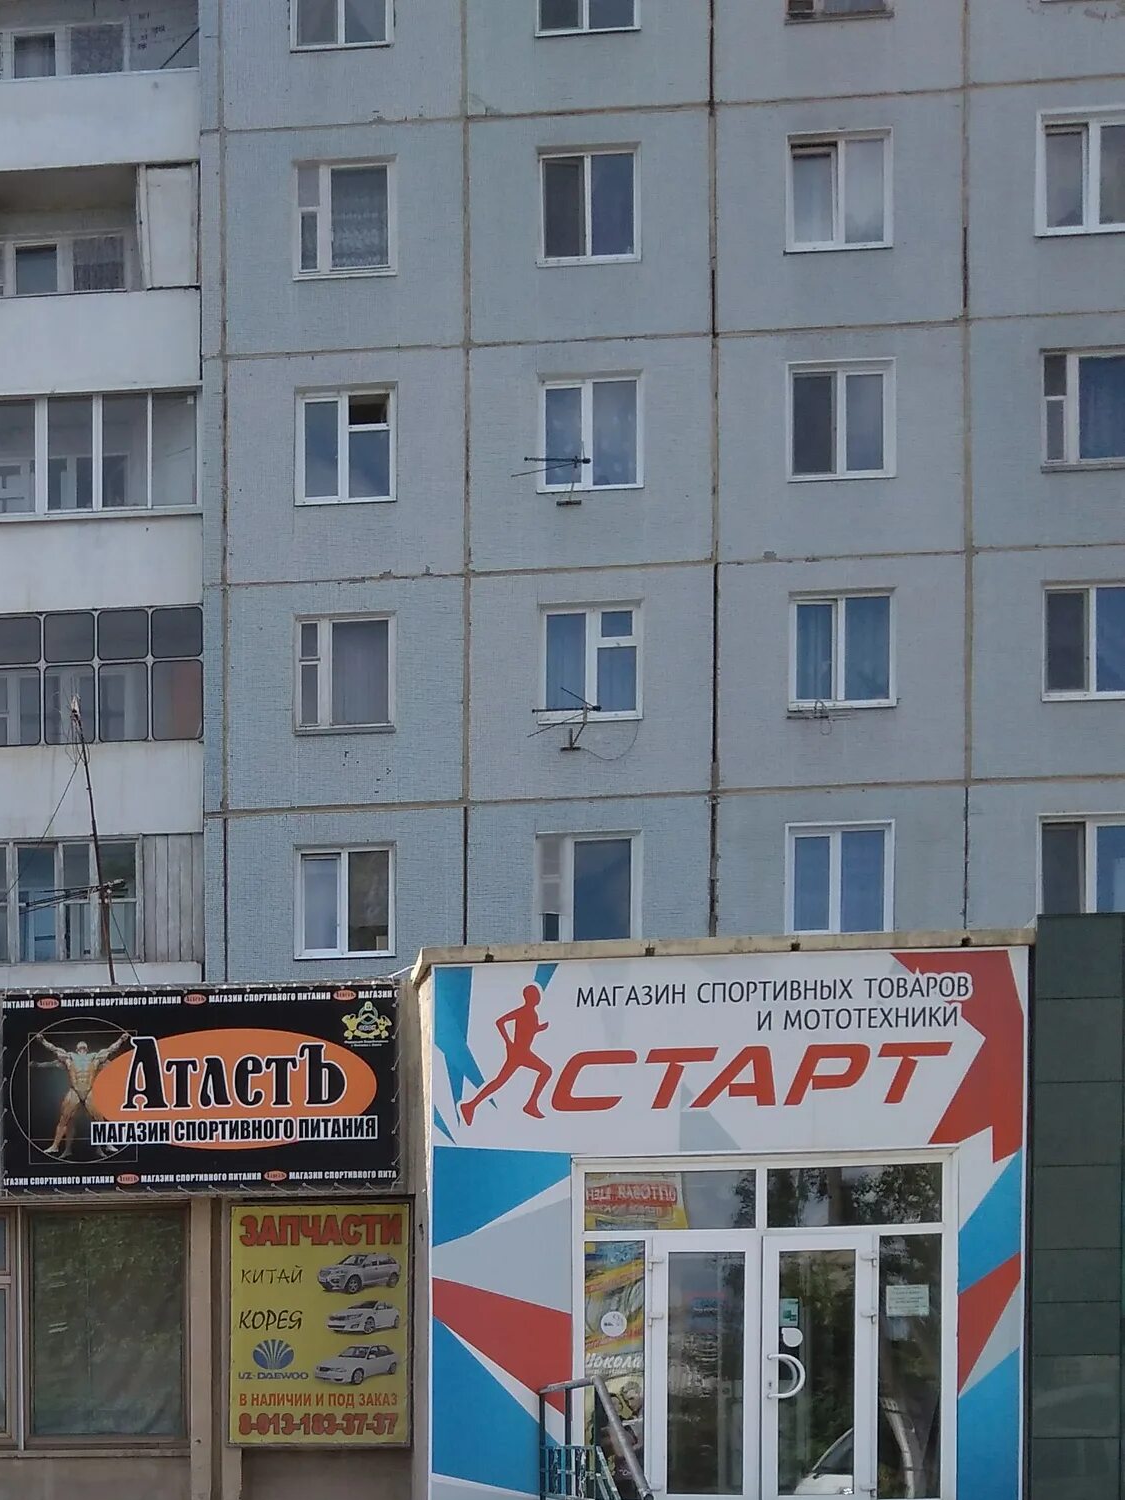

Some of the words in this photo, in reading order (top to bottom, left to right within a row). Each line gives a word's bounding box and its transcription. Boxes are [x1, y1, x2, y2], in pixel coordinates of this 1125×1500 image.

[208, 994, 243, 1003] МАГАЗИН
[244, 993, 296, 1002] СПОРТИВНОГО
[297, 991, 331, 1001] ПИТАНИЯ
[358, 990, 393, 999] МАГАЗИН
[576, 983, 686, 1008] МАГАЗИН
[696, 978, 853, 1004] СПОРТИВНЫХ
[863, 975, 971, 999] ТОВАРОВ
[60, 998, 94, 1007] МАГАЗИН
[95, 997, 147, 1007] СПОРТИВНОГО
[148, 995, 182, 1005] ПИТАНИЯ
[756, 1009, 773, 1032] И
[783, 1006, 959, 1031] МОТОТЕХНИКИ
[550, 1041, 954, 1112] СТАРТ
[92, 1122, 171, 1144] МАГАЗИН
[174, 1119, 295, 1142] СПОРТИВНОГО
[298, 1116, 377, 1139] ПИТАНИЯ
[29, 1176, 81, 1185] СПОРТИВНОГО
[81, 1175, 115, 1185] ПИТАНИЯ
[140, 1174, 175, 1184] МАГАЗИН
[175, 1173, 227, 1183] СПОРТИВНОГО
[228, 1172, 262, 1181] ПИТАНИЯ
[288, 1171, 323, 1180] МАГАЗИН
[324, 1170, 377, 1180] СПОРТИВНОГО
[239, 1213, 403, 1246] ЗАПЧАСТИ
[240, 1265, 303, 1285] КИТАЙ
[238, 1309, 303, 1330] КОРЕЯ
[239, 1393, 248, 1407] В
[251, 1392, 312, 1407] НАЛИЧИИ
[315, 1392, 325, 1407] И
[328, 1392, 356, 1409] ПОД
[358, 1392, 398, 1407] ЗАКАЗ
